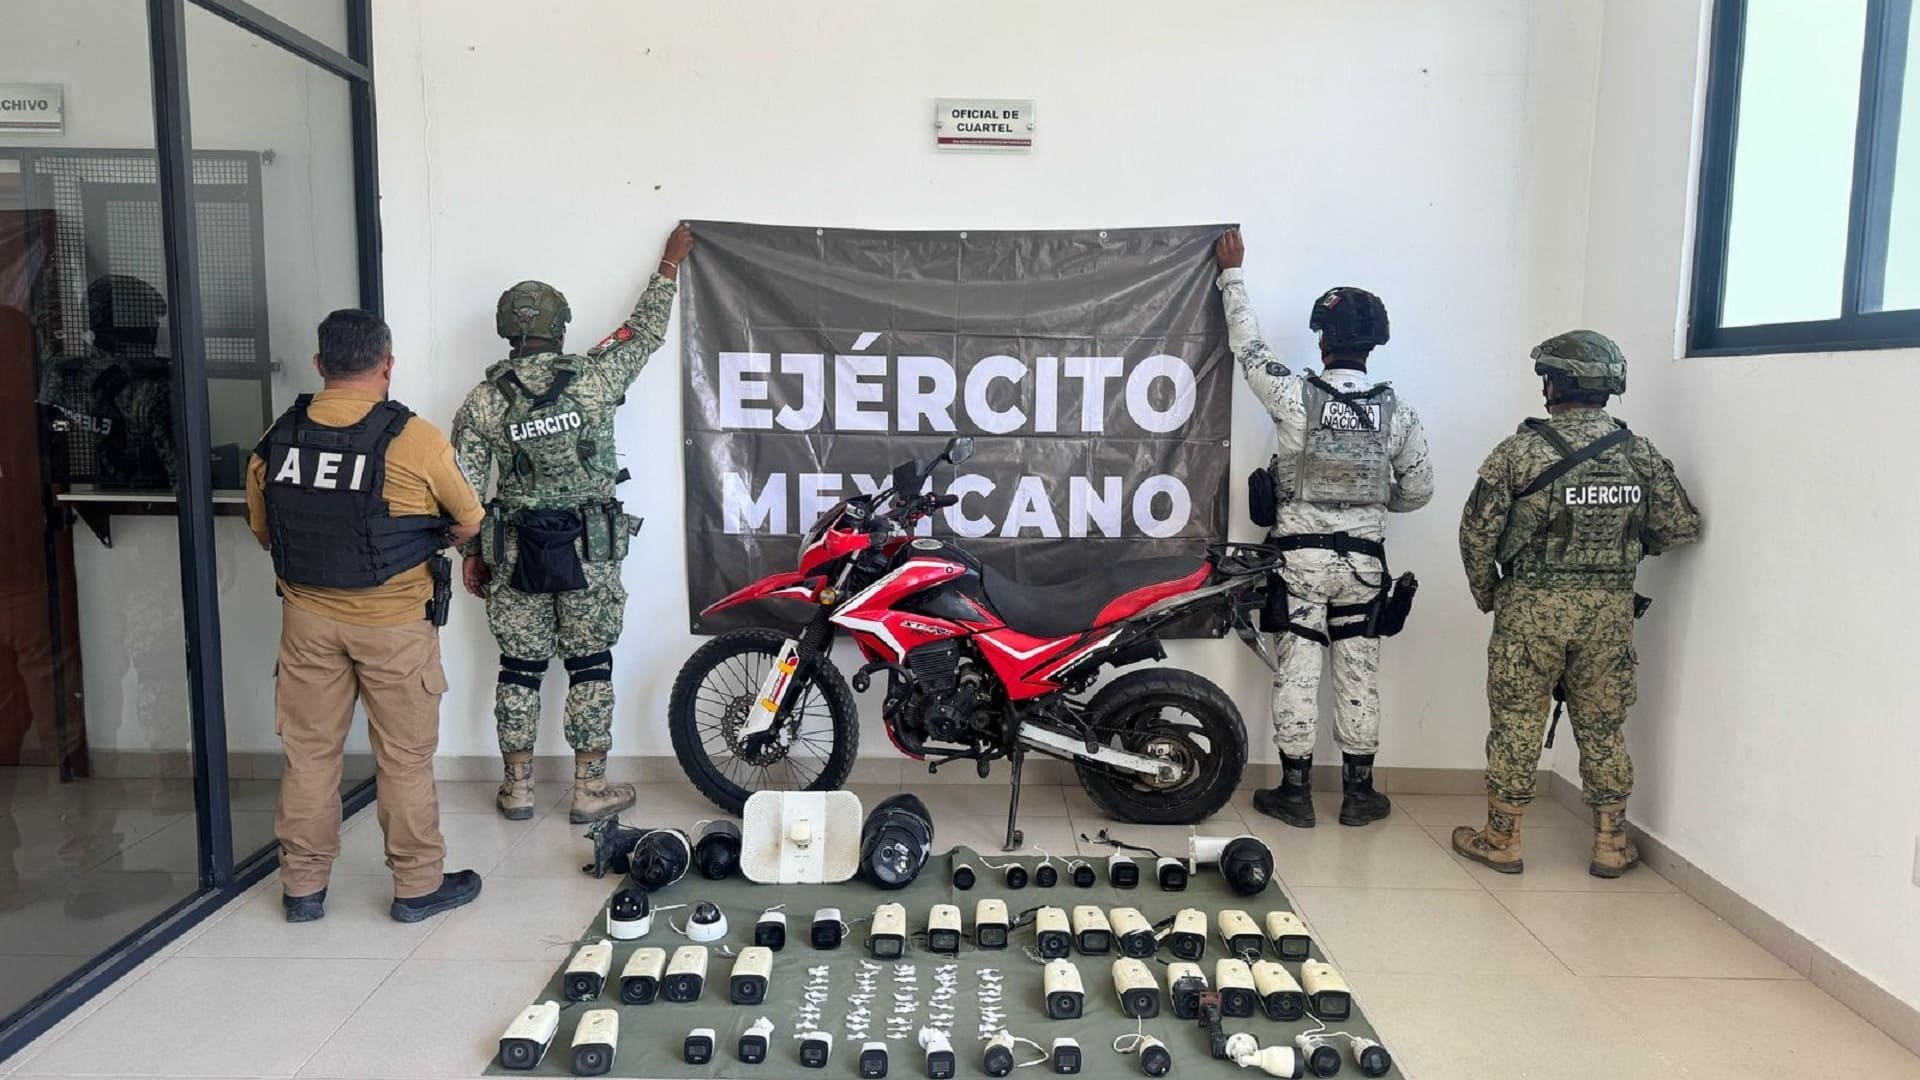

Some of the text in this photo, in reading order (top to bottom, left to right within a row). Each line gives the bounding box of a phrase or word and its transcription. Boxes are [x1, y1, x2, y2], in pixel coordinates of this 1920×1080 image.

[952, 109, 1019, 120] OFICIAL DE
[956, 123, 1013, 133] CUARTEL
[719, 332, 1197, 433] EJÉRCITO
[509, 411, 581, 441] EJERCITO
